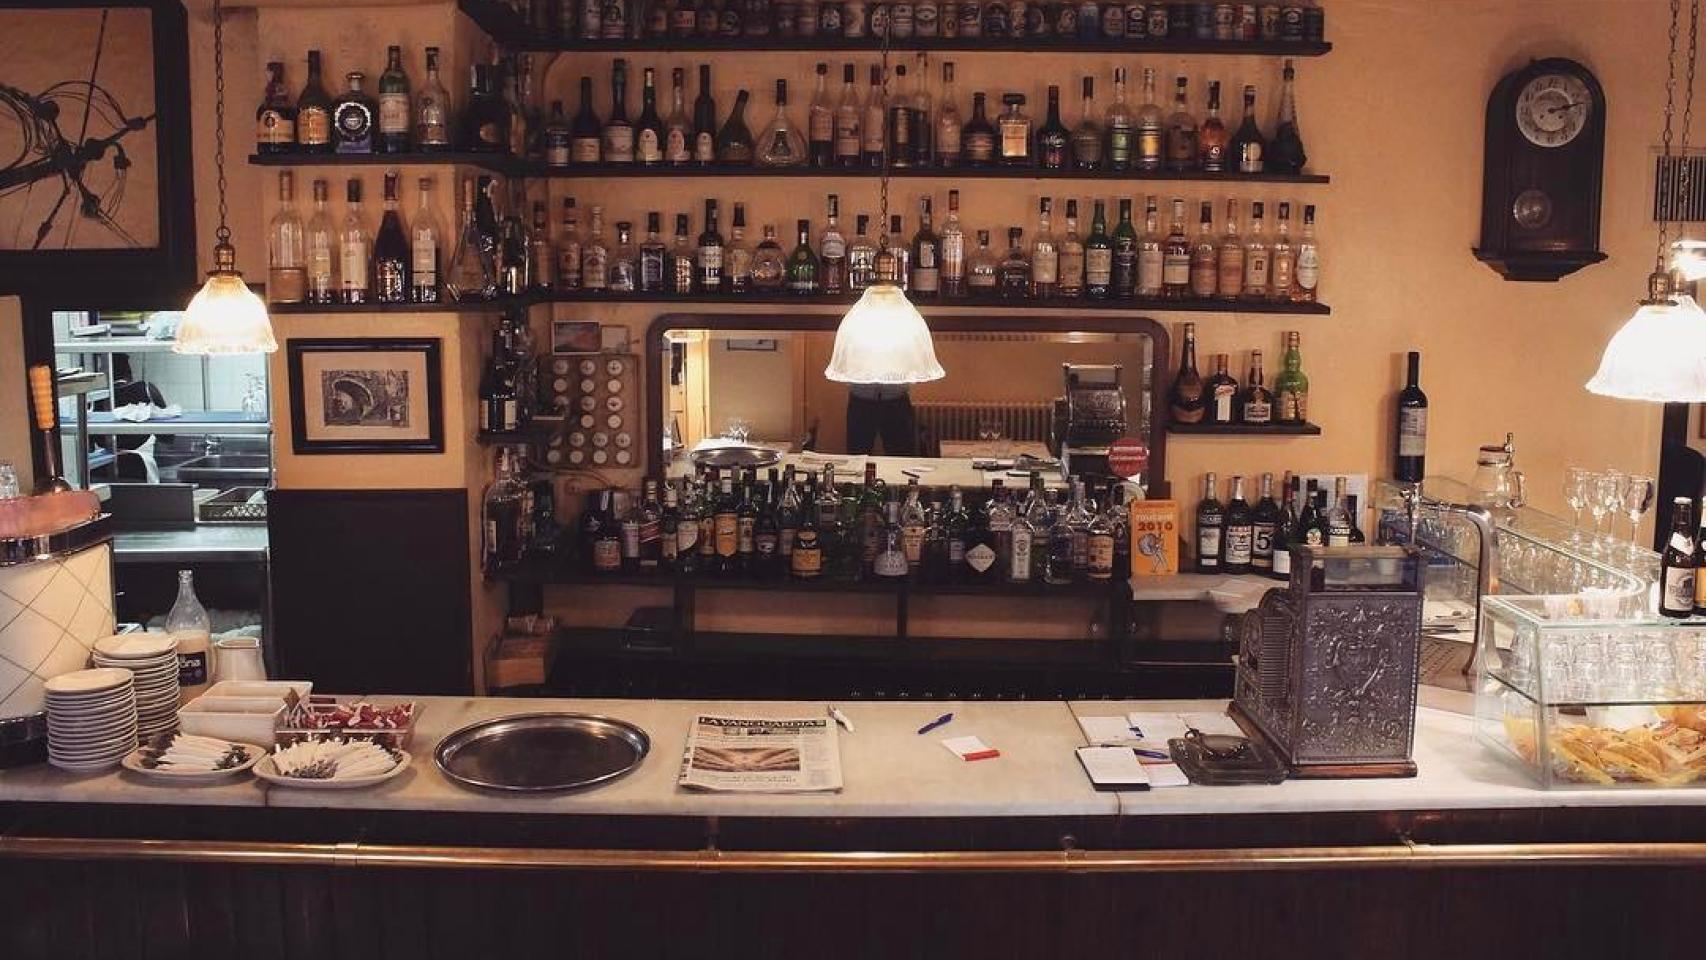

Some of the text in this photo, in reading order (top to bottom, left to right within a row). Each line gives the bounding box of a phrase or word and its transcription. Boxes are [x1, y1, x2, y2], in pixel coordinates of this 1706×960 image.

[1137, 521, 1173, 531] 2010
[1256, 531, 1273, 550] 5
[701, 717, 815, 727] LA VANGUARDIA
